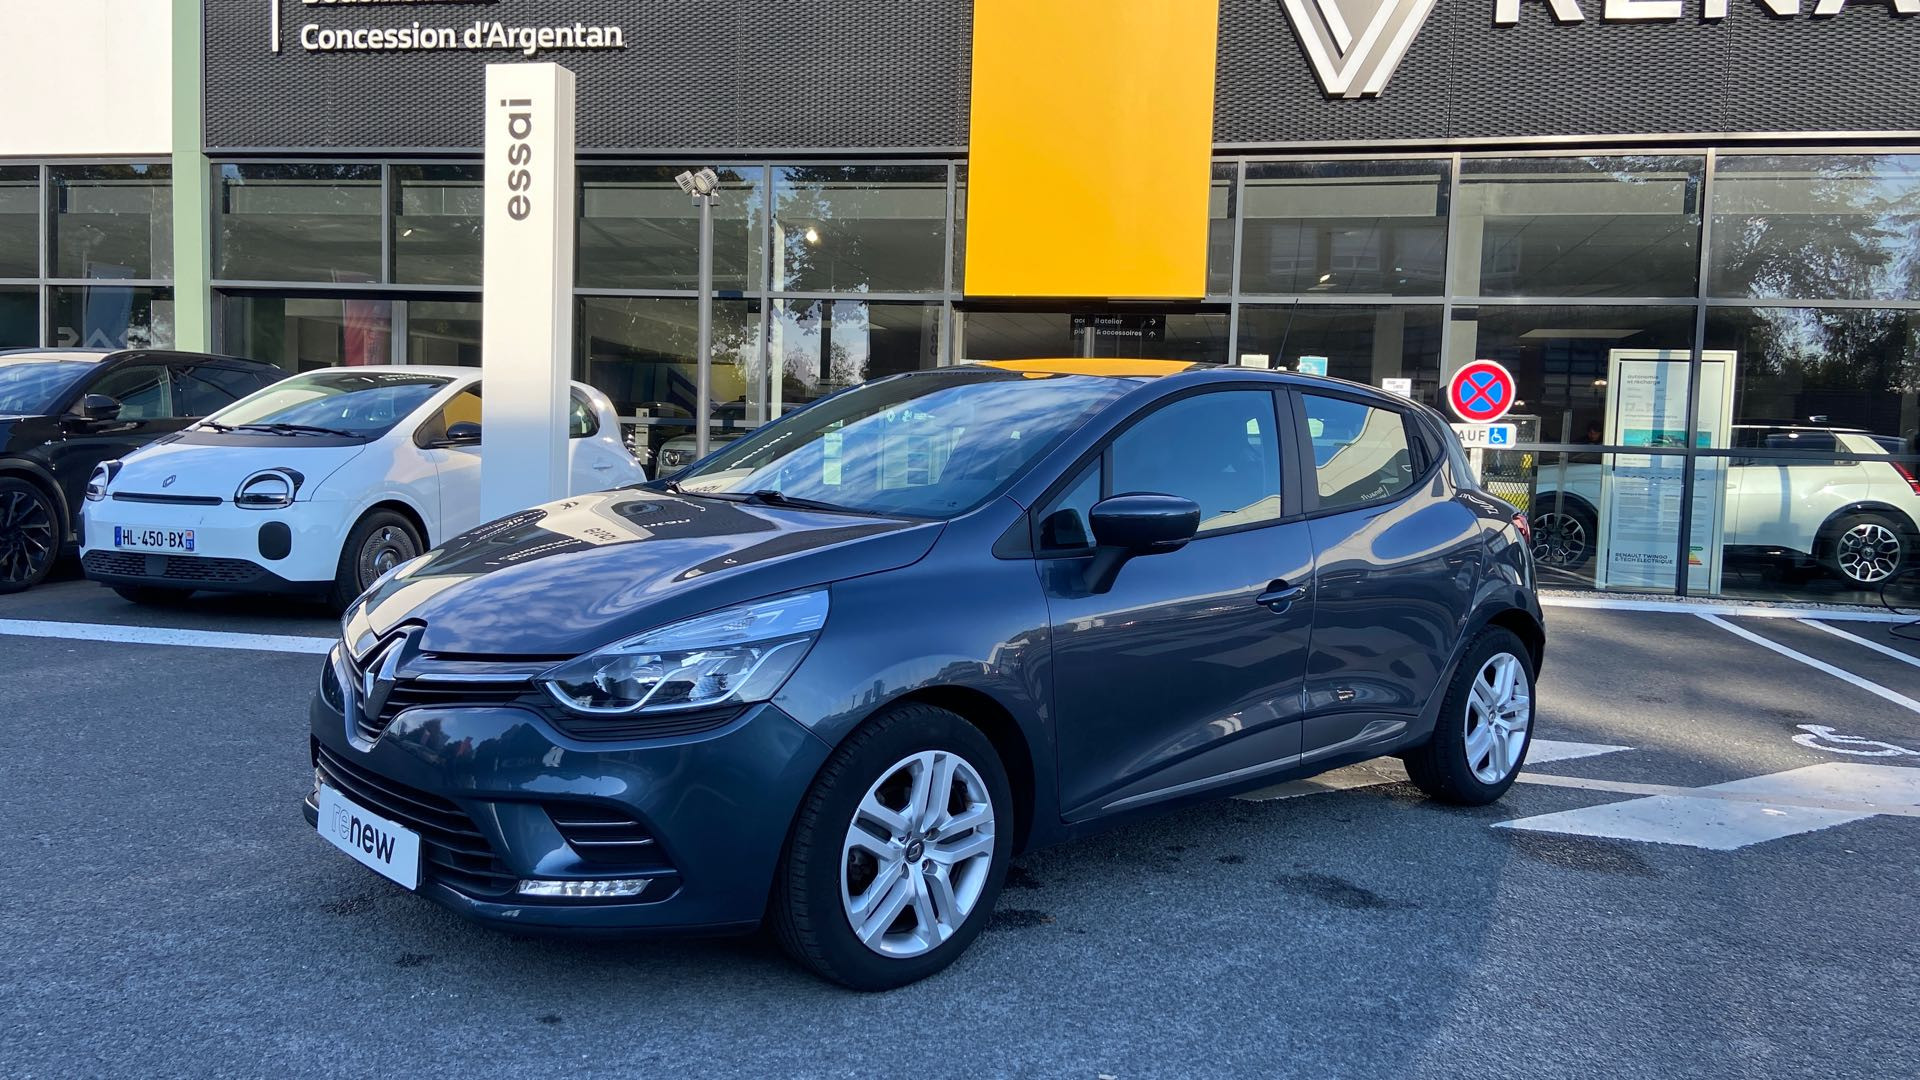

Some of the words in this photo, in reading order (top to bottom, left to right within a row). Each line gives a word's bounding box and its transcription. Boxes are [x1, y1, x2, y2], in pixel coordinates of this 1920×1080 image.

[300, 22, 457, 50] Concession
[463, 21, 623, 54] d'Argentan
[500, 98, 532, 221] essai
[1102, 329, 1142, 337] accessoires
[1457, 429, 1486, 441] AUF
[122, 529, 185, 548] HL-450-BX
[331, 803, 396, 865] renew
